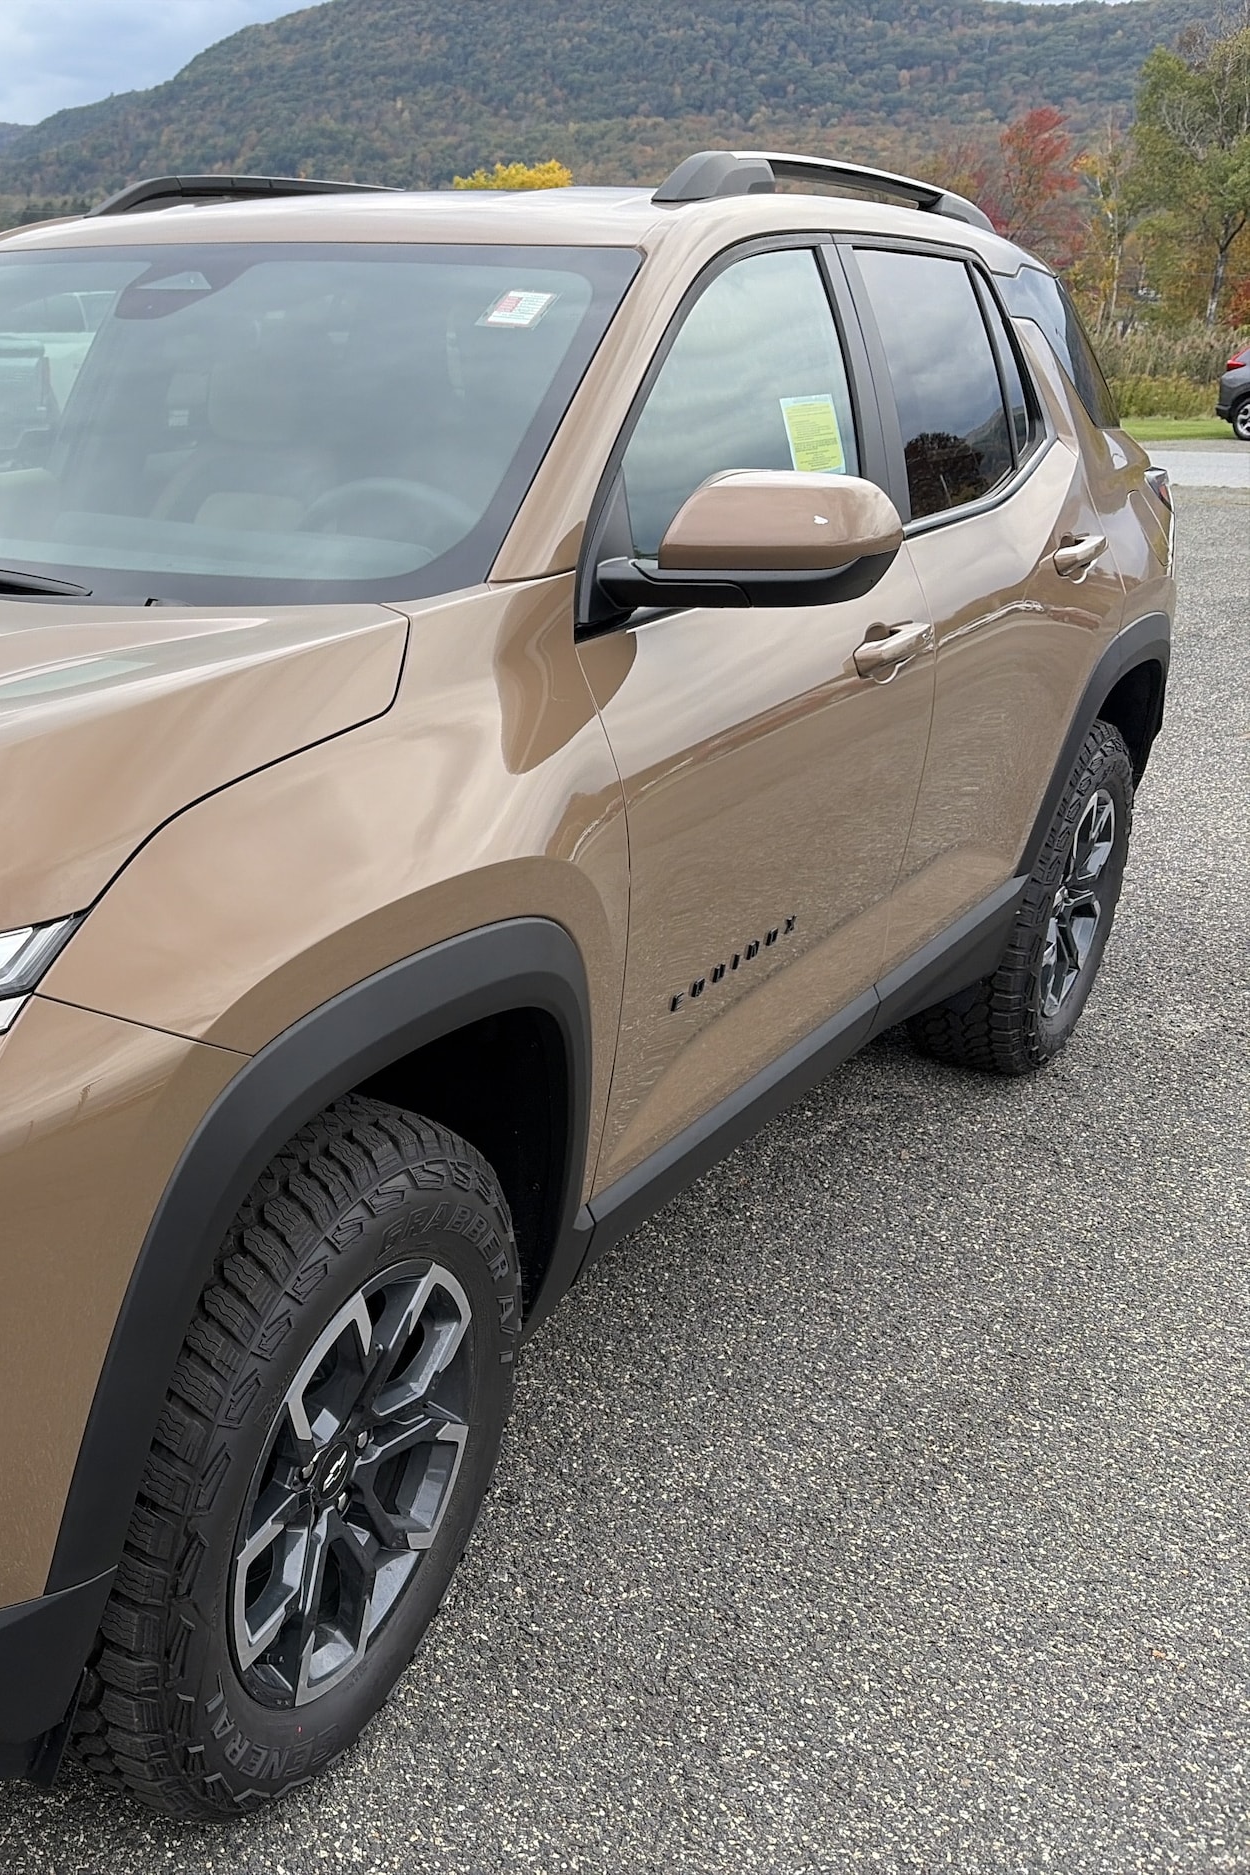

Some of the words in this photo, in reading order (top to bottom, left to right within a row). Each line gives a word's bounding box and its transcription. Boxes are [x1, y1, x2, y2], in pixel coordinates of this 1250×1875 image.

[669, 915, 797, 1012] EQUINOX
[377, 1202, 510, 1284] GRABBER
[205, 1672, 341, 1780] GENERAL
